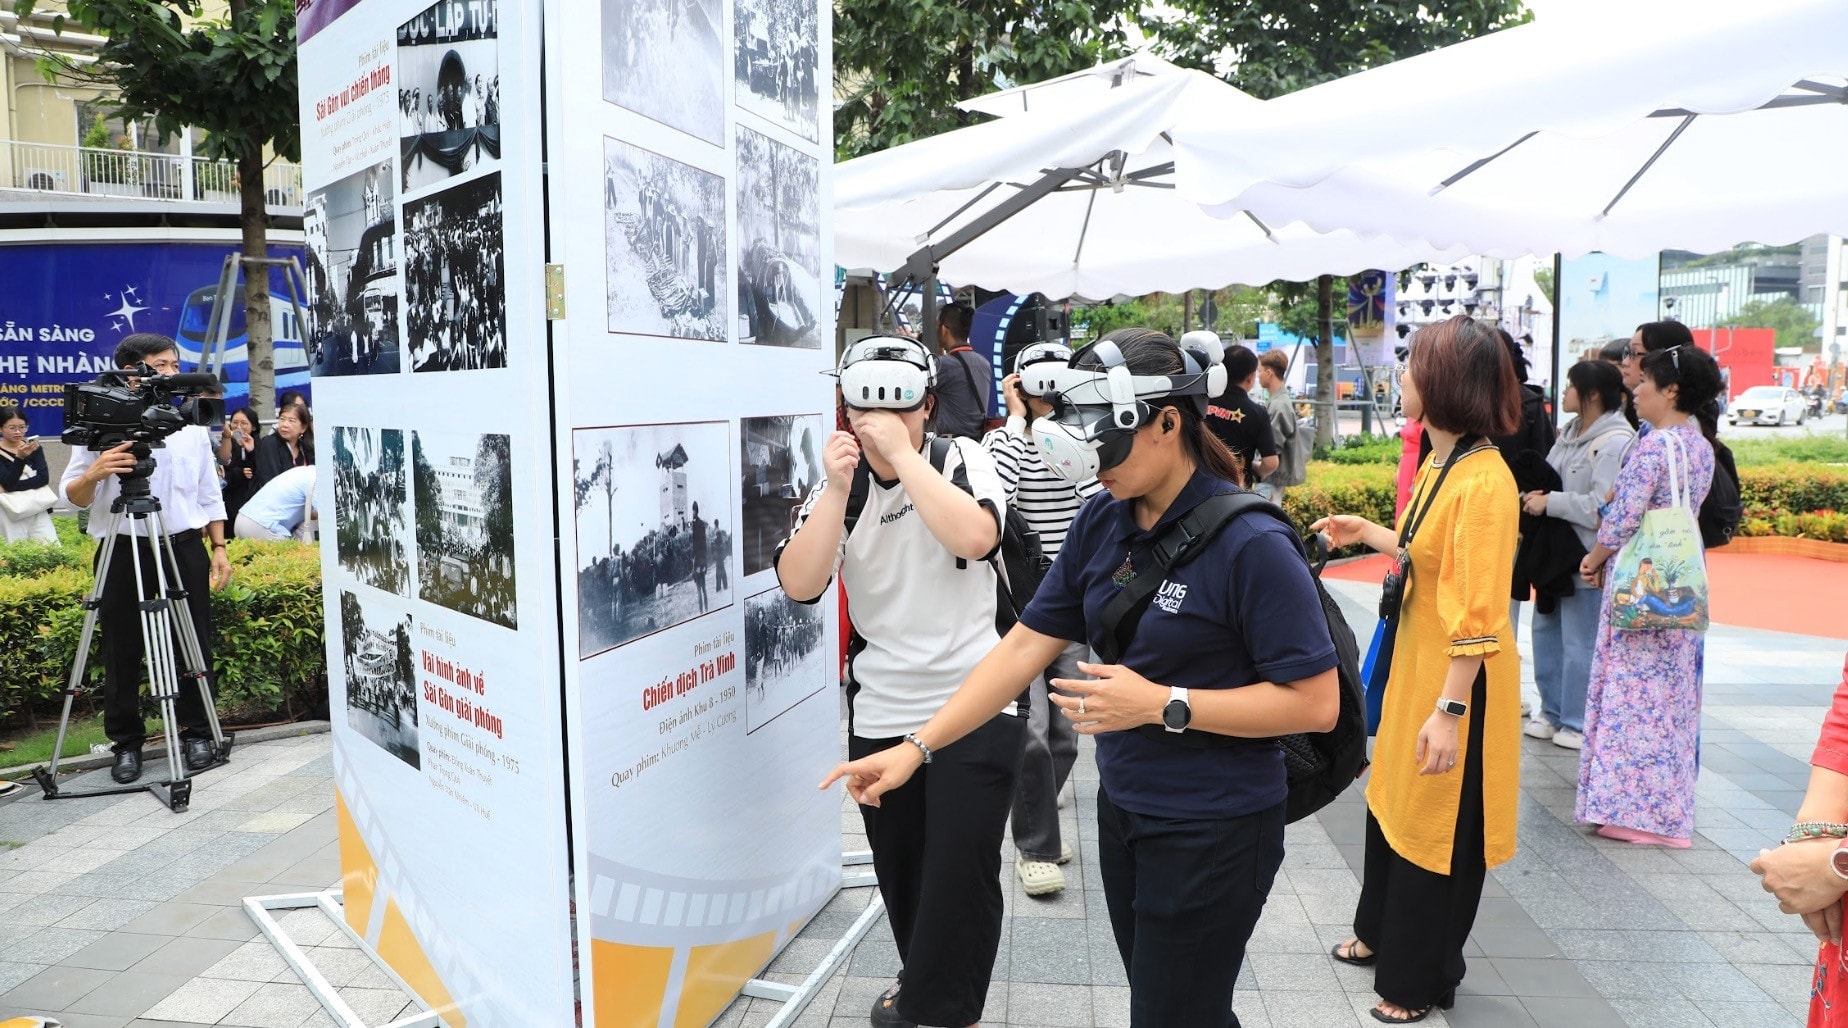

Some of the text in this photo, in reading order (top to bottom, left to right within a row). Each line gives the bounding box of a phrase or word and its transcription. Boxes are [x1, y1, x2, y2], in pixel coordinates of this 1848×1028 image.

[316, 60, 390, 121] Sài Gòn vui chiến thắng
[39, 324, 95, 342] SÀNG
[419, 622, 434, 639] Phim
[445, 630, 456, 648] liệu
[694, 631, 735, 657] Phim tài liệu
[421, 649, 435, 674] Vài
[436, 656, 454, 682] hình
[456, 661, 472, 690] ảnh
[474, 670, 485, 696] về
[643, 651, 735, 711] Chiến dịch Trà Vinh
[423, 680, 502, 740] Sài Gòn giải phóng
[659, 717, 677, 734] Điện
[679, 707, 693, 725] ảnh
[694, 700, 707, 717] Khu
[720, 685, 736, 704] 1950
[444, 724, 459, 743] phim
[502, 754, 520, 774] 1975
[611, 768, 633, 788] Quay
[636, 753, 659, 777] phim:
